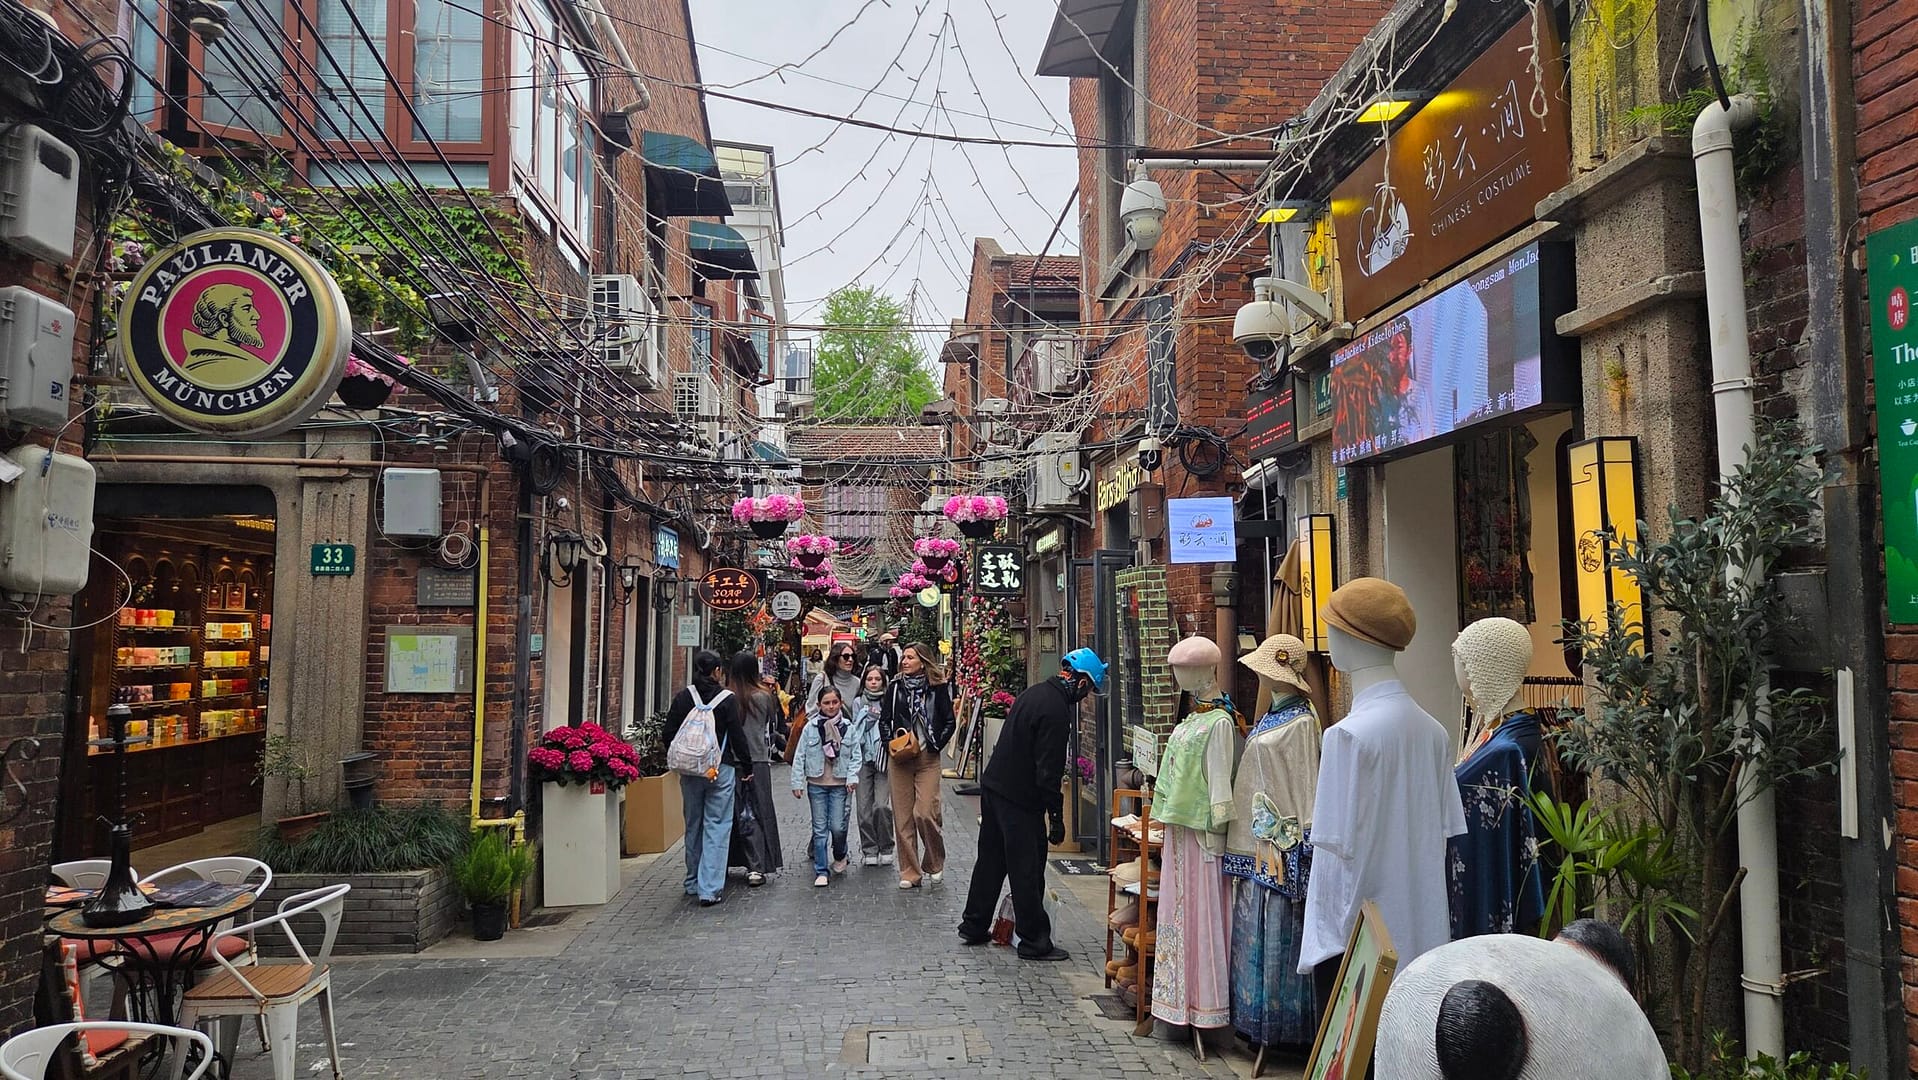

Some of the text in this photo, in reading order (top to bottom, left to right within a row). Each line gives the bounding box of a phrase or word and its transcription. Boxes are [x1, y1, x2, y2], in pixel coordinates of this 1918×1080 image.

[1430, 159, 1533, 237] CHINESE COSTUME
[140, 243, 307, 308] PAULANER
[152, 367, 294, 411] MÜNCHEN
[322, 547, 343, 564] 33
[706, 574, 750, 588] 手工皂
[713, 589, 742, 598] SOAP
